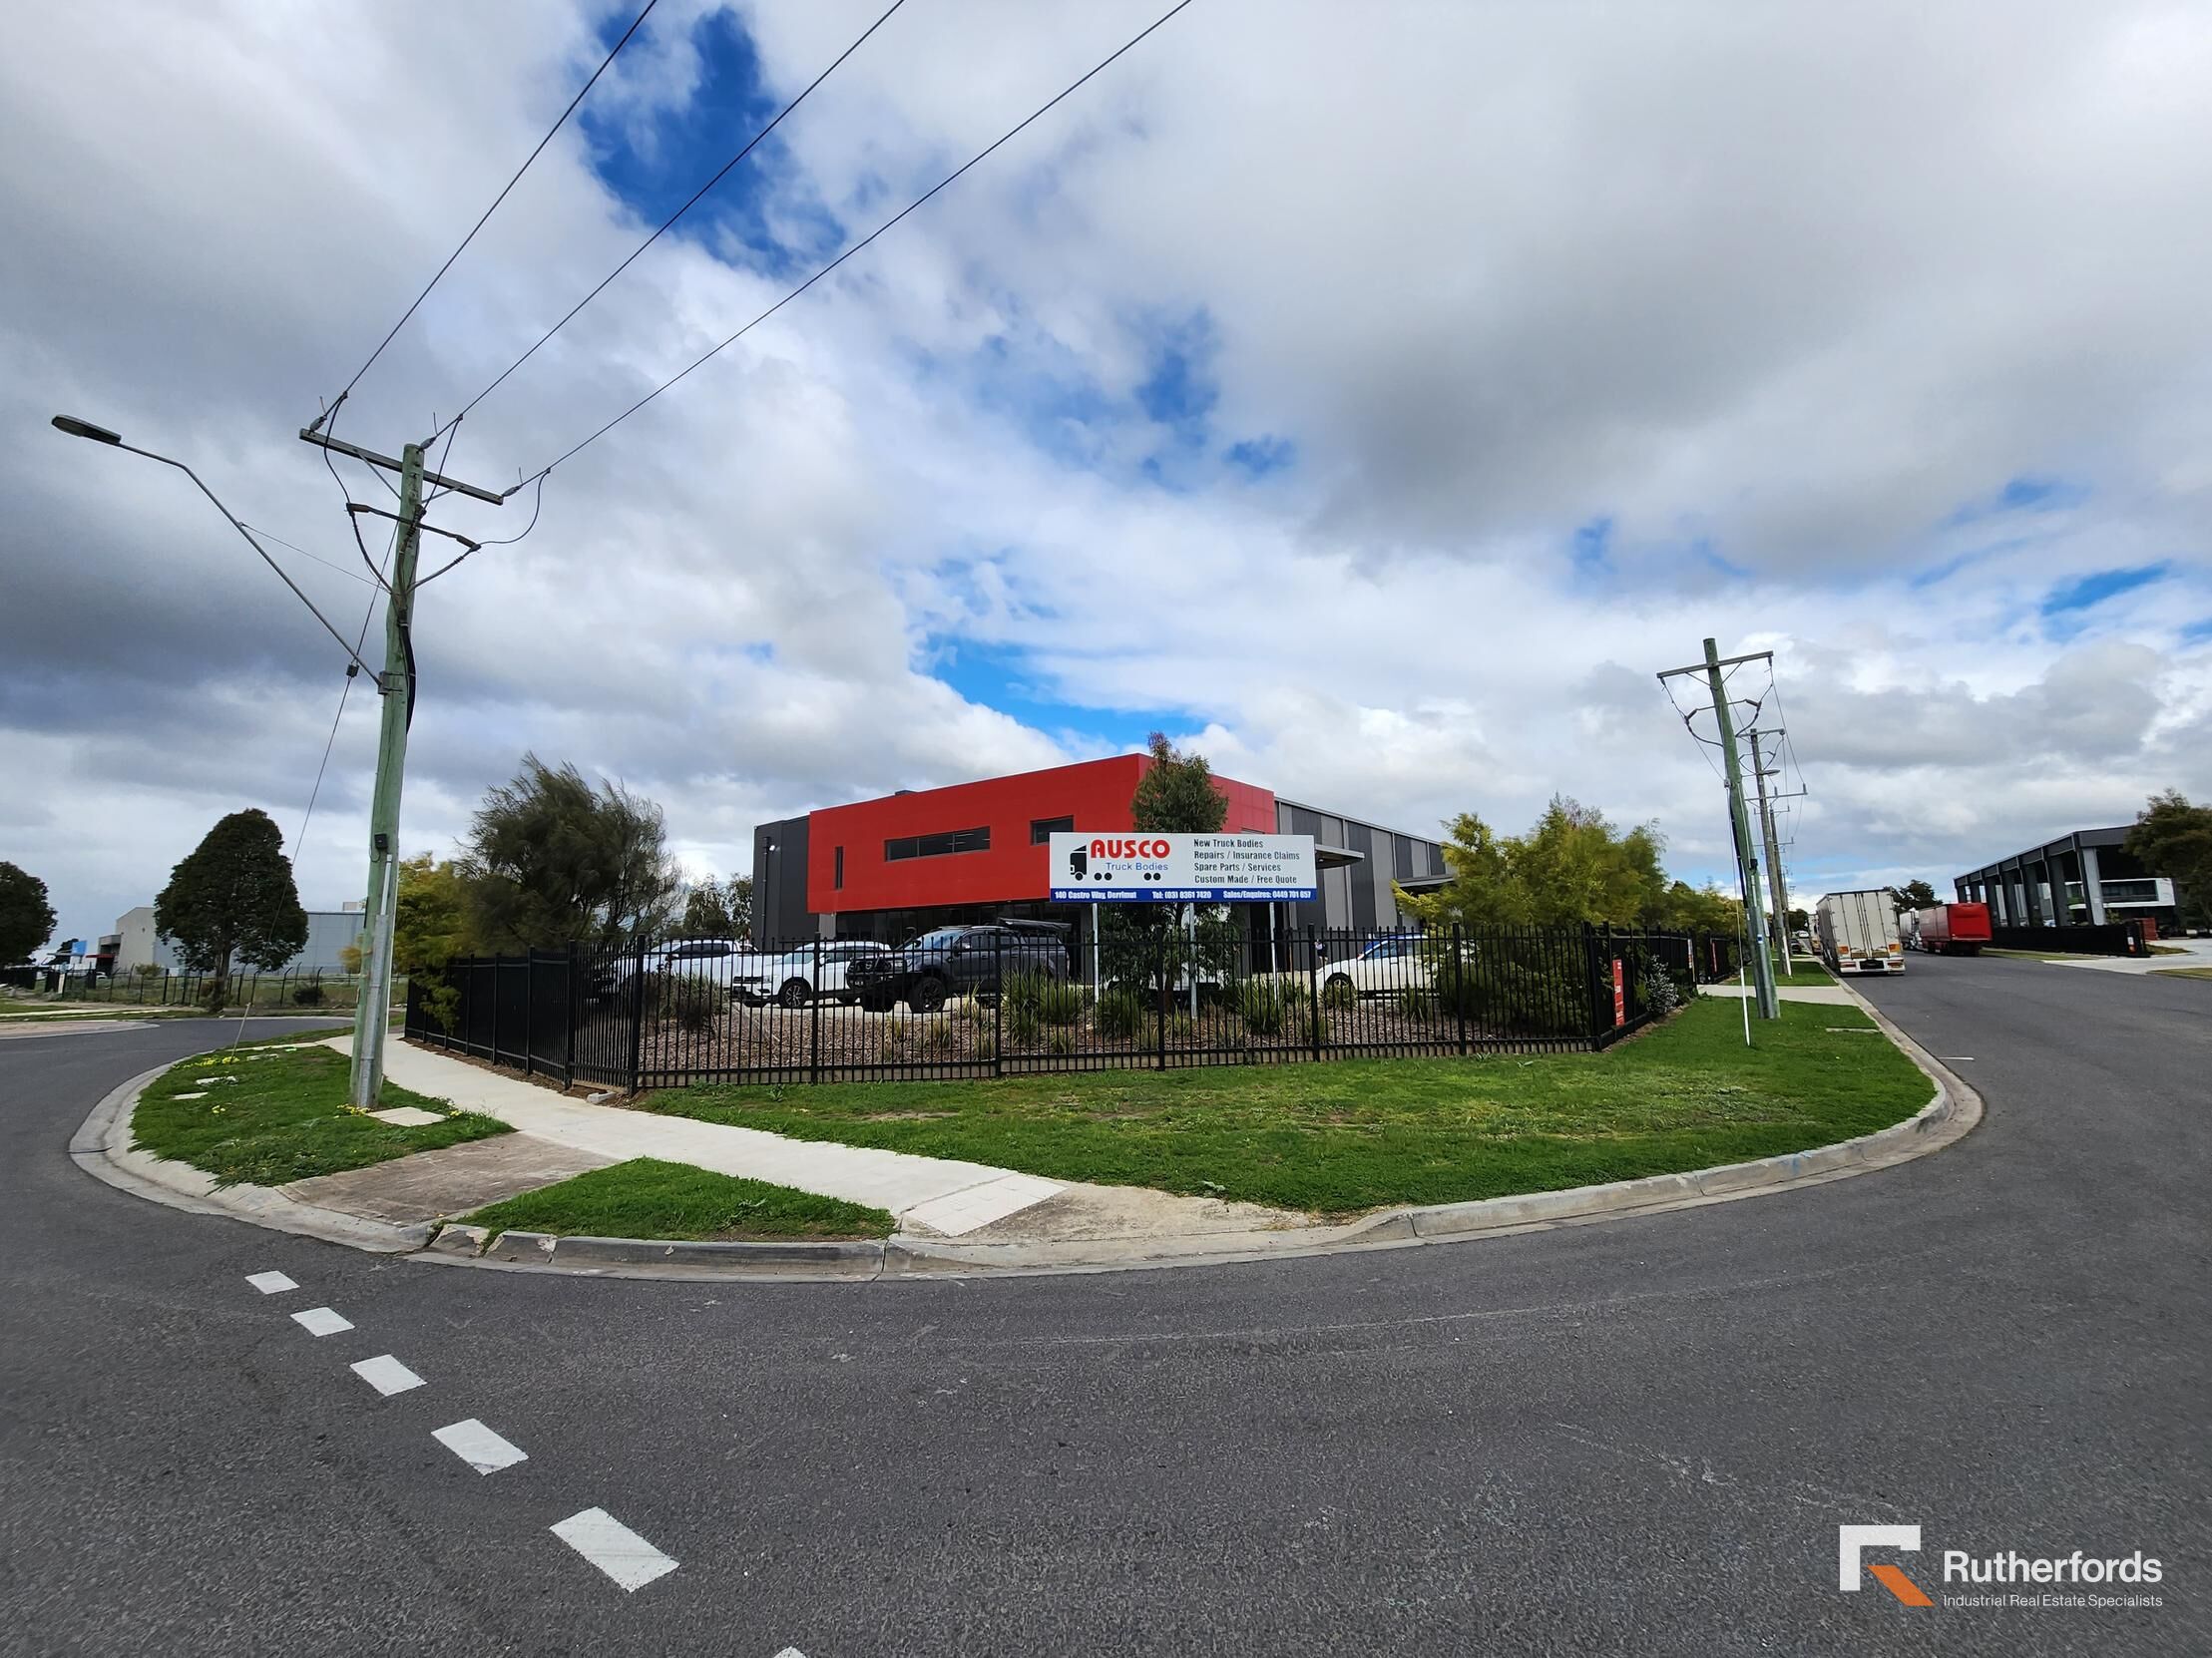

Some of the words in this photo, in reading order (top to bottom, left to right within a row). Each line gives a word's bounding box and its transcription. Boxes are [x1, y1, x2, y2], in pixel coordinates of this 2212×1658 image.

[1193, 838, 1210, 847] New
[1213, 839, 1235, 848] Truck
[1237, 839, 1264, 848] Bodies
[1091, 839, 1170, 859] AUSCO
[1194, 851, 1225, 860] Repairs
[1226, 851, 1231, 860] /
[1232, 851, 1272, 860] Insurance
[1274, 851, 1300, 860] Claims
[1106, 862, 1132, 871] Truck
[1135, 862, 1168, 871] Bodies
[1194, 862, 1217, 872] Spare
[1241, 863, 1246, 872] /
[1247, 863, 1281, 872] Services
[1194, 875, 1225, 884] Custom
[1227, 875, 1249, 884] Made
[1250, 875, 1255, 884] /
[1256, 875, 1273, 884] Free
[1275, 875, 1297, 884] Quote
